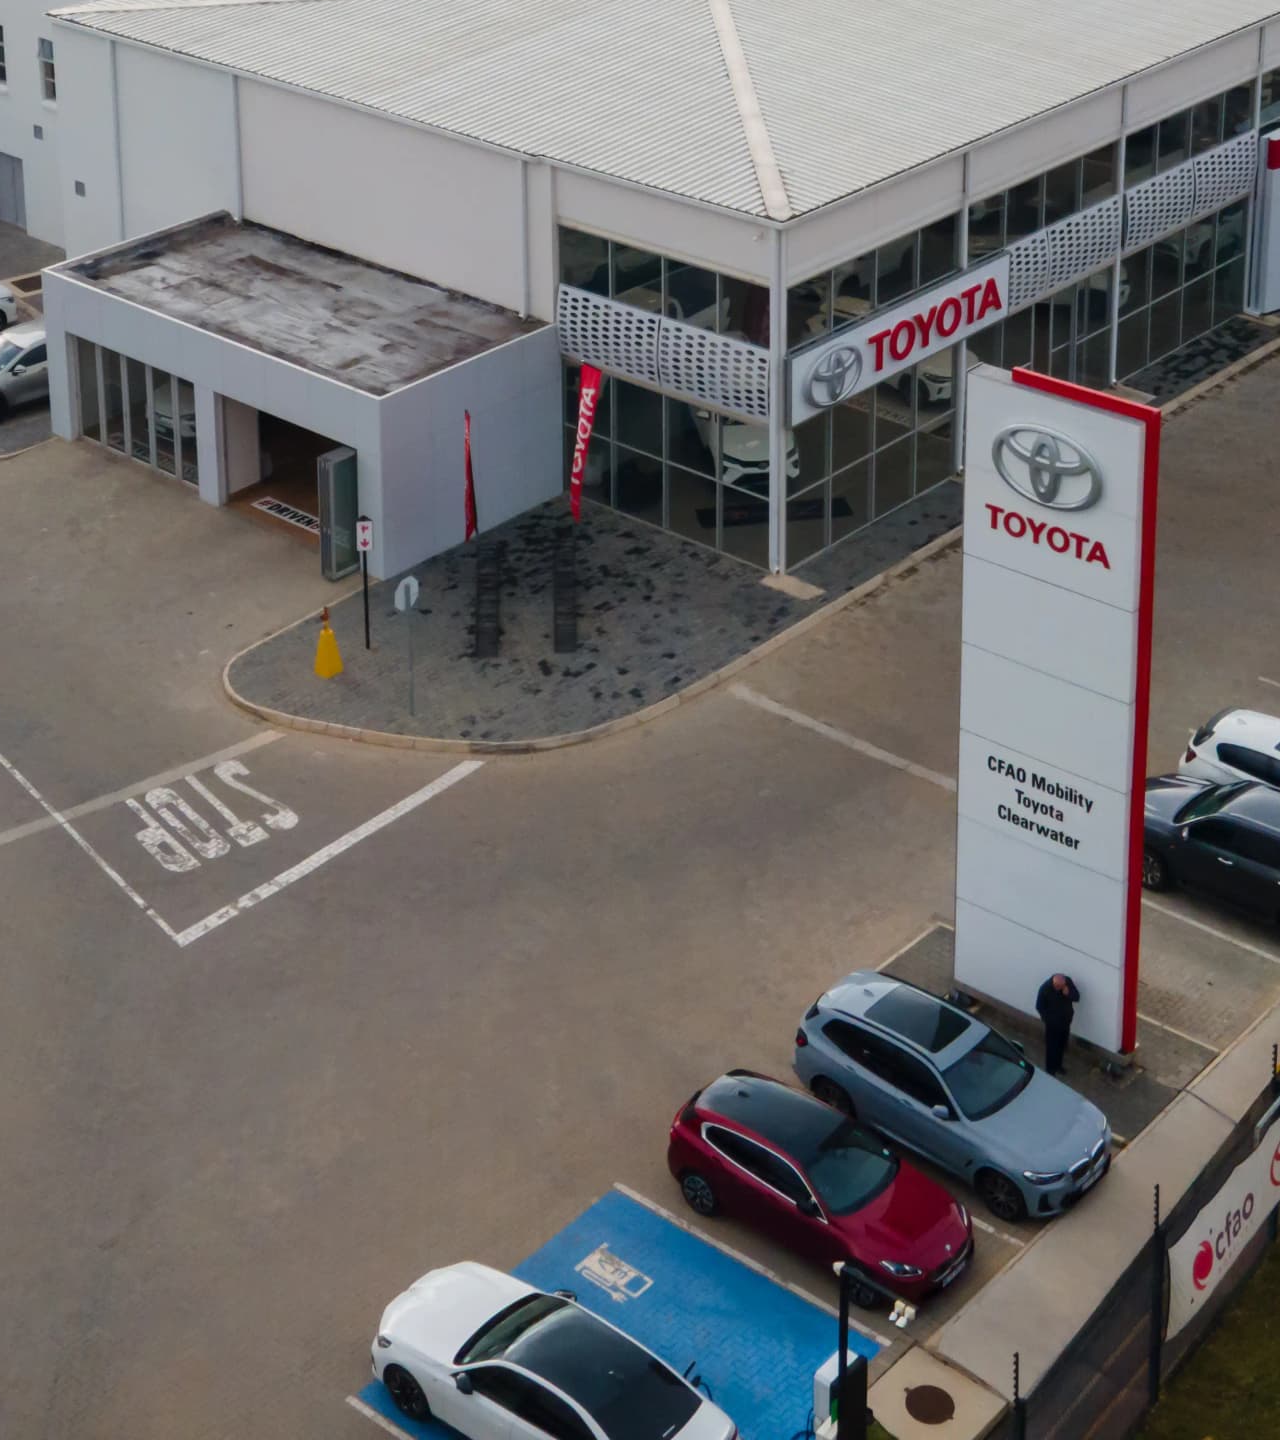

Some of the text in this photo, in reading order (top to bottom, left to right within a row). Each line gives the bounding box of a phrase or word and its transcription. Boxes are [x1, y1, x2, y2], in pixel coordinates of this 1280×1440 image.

[868, 277, 1002, 372] TOYOTA
[985, 502, 1111, 570] TOYOTA
[125, 760, 299, 872] STOP
[987, 755, 1094, 814] CFAO Mobility
[1015, 788, 1064, 822] Toyota
[997, 804, 1080, 850] Clearwater
[1215, 1192, 1254, 1260] cfao
